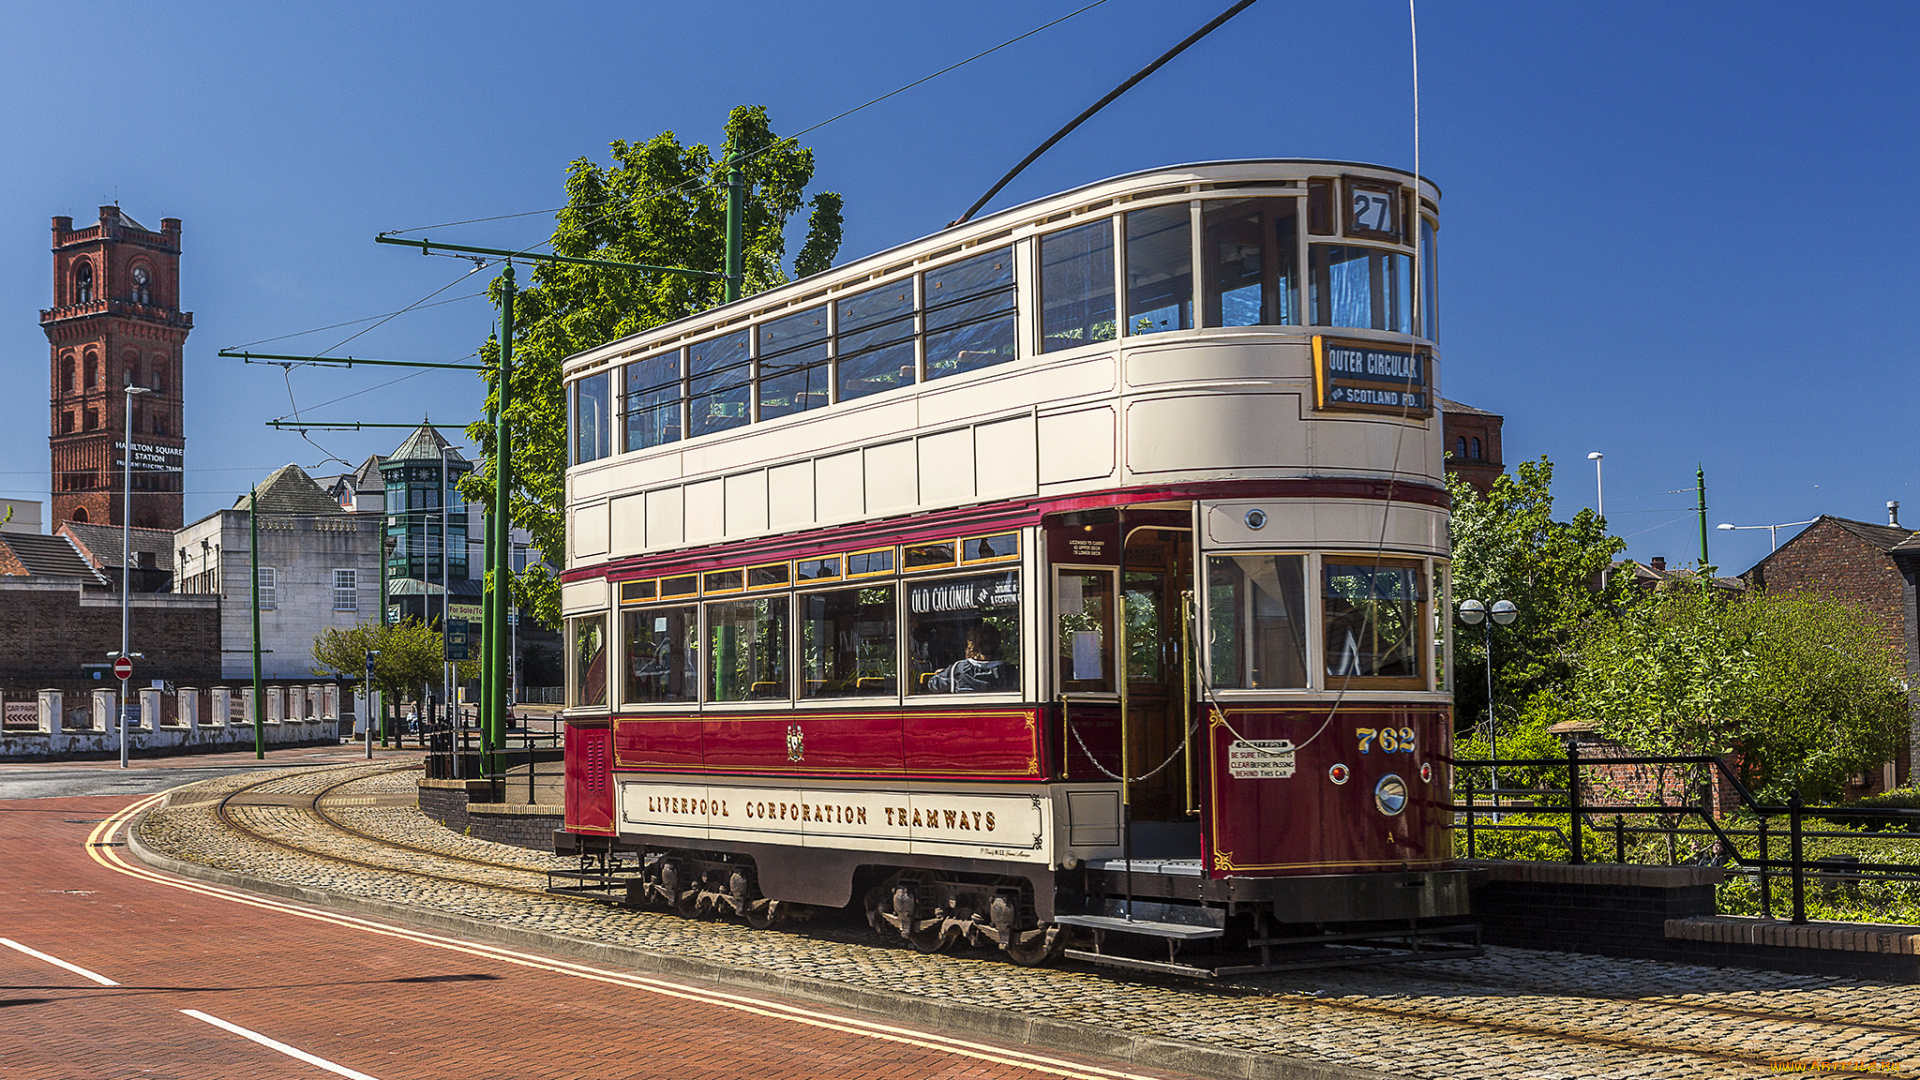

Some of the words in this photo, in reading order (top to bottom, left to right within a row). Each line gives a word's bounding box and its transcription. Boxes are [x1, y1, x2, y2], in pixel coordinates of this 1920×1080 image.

[1354, 194, 1388, 230] 27
[1329, 349, 1362, 373] OUTER
[1367, 353, 1417, 378] CIRCULAR
[1346, 389, 1398, 405] SCOTLAND
[115, 441, 153, 453] HAILTON
[155, 446, 183, 456] SQUARE
[135, 453, 165, 462] STATION
[912, 589, 930, 613] OLD
[933, 584, 979, 611] COLONIAL
[1356, 727, 1416, 754] 762
[648, 796, 729, 817] LIVERPOOL
[746, 800, 867, 825] CORPORATION
[885, 807, 996, 832] TRAMWAYS
